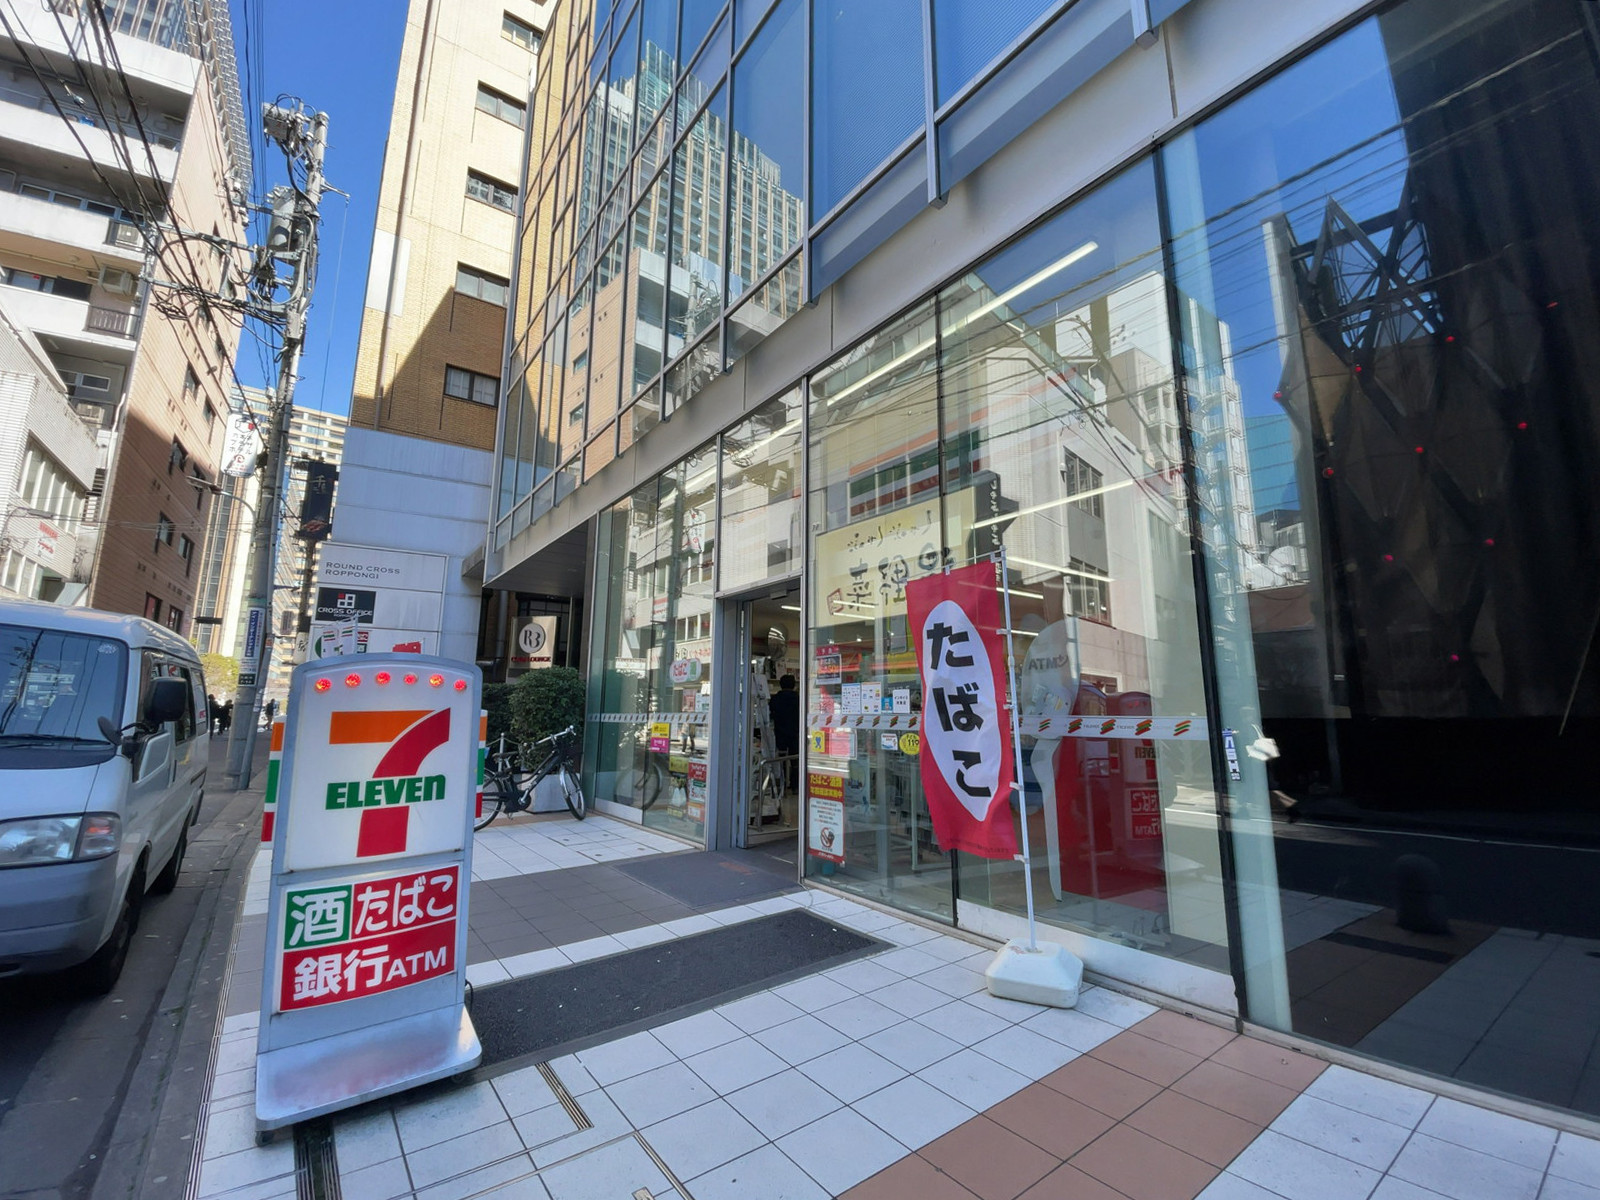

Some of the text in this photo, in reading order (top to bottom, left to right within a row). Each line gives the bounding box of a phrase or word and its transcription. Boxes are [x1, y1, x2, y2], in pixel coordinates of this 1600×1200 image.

[325, 562, 400, 574] ROUND CROSS
[325, 569, 379, 579] ROPPONGI
[346, 608, 373, 616] OFFICE
[1028, 657, 1058, 670] ATM
[926, 622, 991, 798] たばこ
[328, 707, 451, 858] 7
[289, 874, 453, 946] 酒 たばこ
